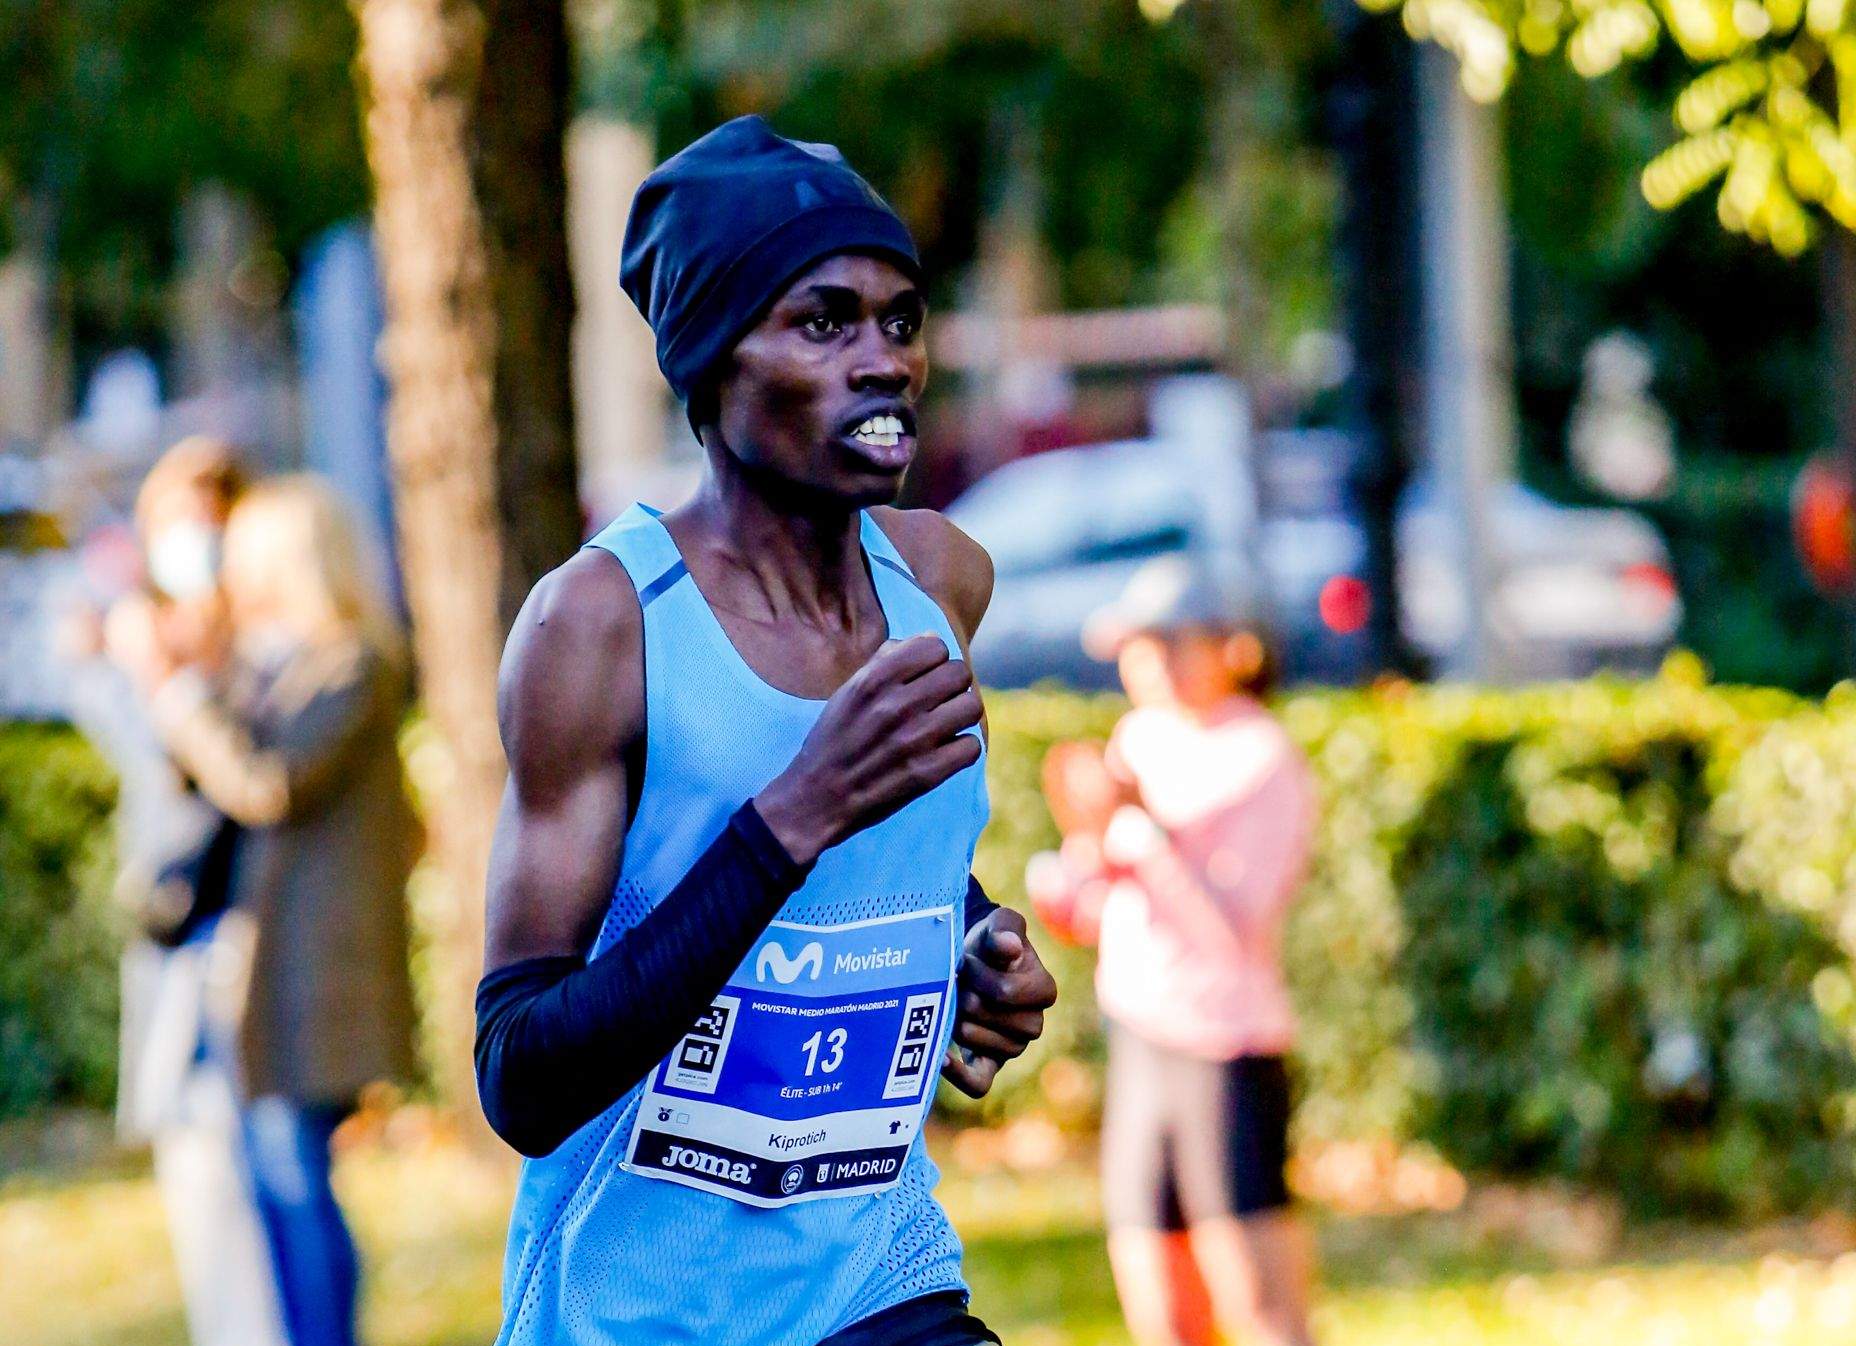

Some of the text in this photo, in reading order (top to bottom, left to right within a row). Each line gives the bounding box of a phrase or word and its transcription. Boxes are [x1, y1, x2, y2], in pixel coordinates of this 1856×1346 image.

[834, 947, 911, 975] Movistar
[752, 999, 899, 1017] MOVISTAR MEDIO MARATÓN MADRID 2021
[801, 1027, 848, 1077] 13
[808, 1085, 822, 1097] SUB
[768, 1129, 827, 1152] Kiprotich
[836, 1158, 897, 1179] MADRID
